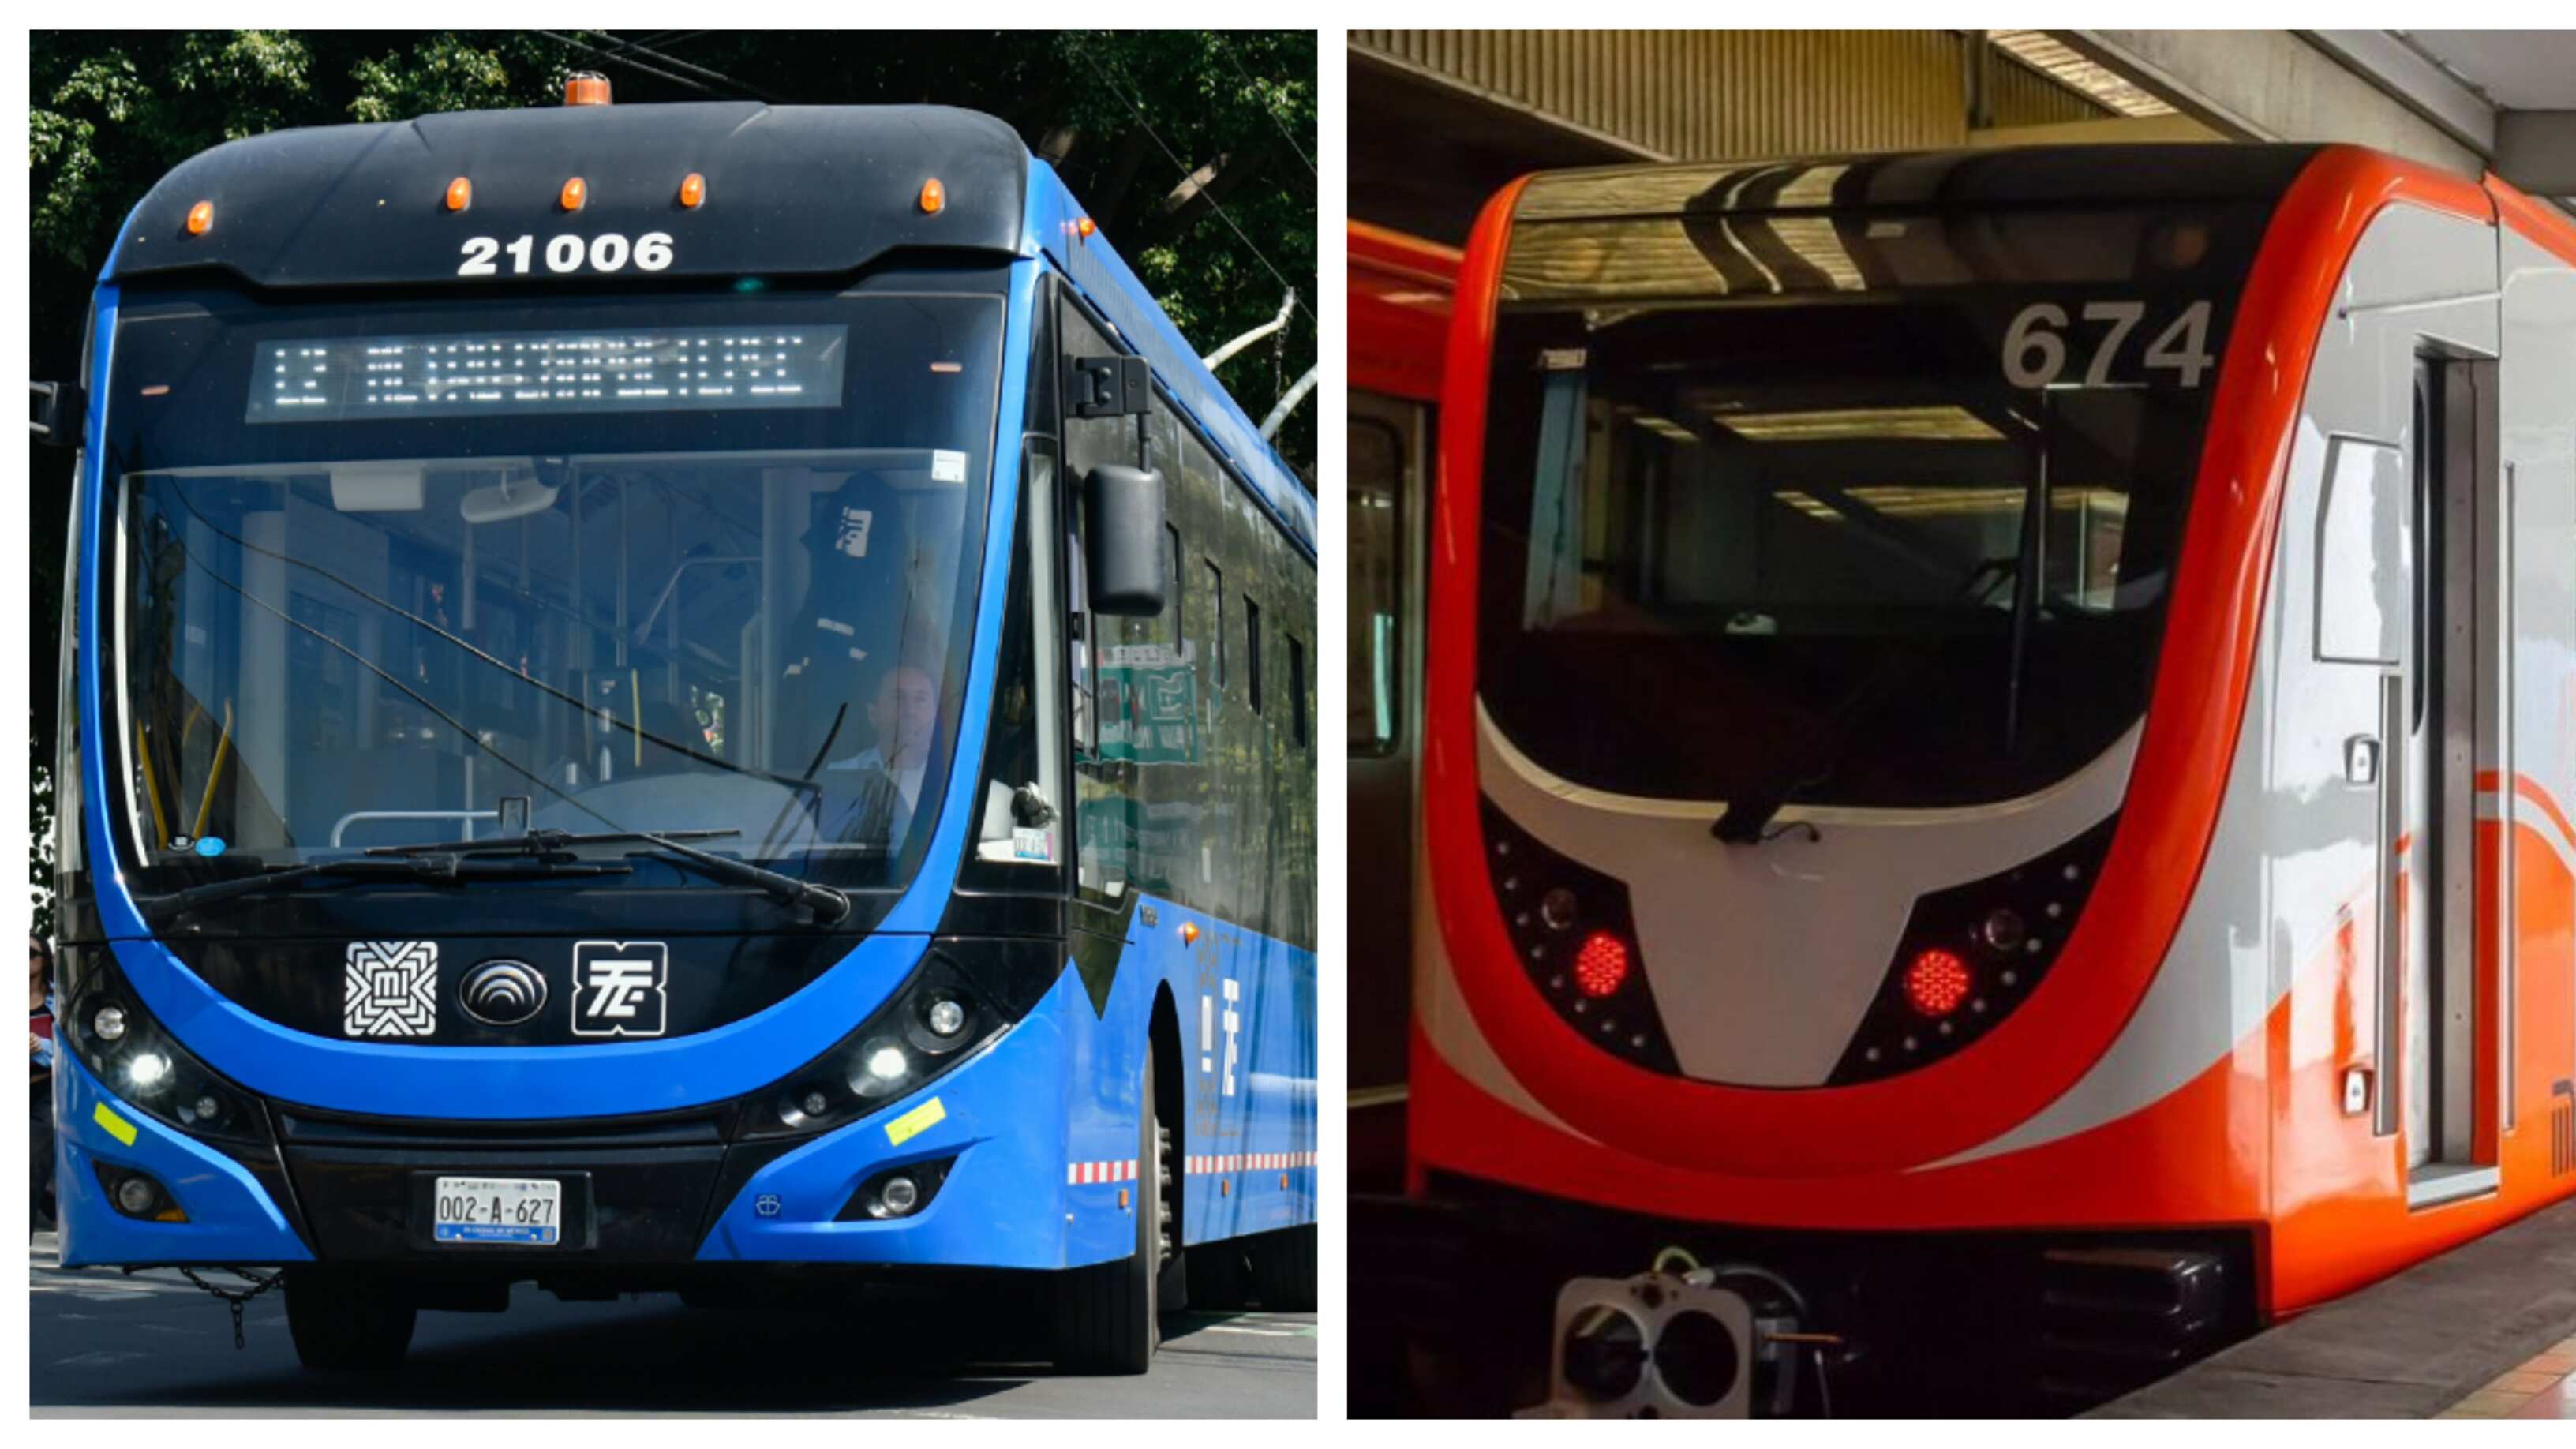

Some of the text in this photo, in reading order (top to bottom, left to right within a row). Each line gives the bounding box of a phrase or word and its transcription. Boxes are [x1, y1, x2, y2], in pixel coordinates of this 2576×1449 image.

[457, 231, 674, 275] 21006
[2002, 299, 2214, 388] 674
[439, 1196, 555, 1224] 002-A-627
